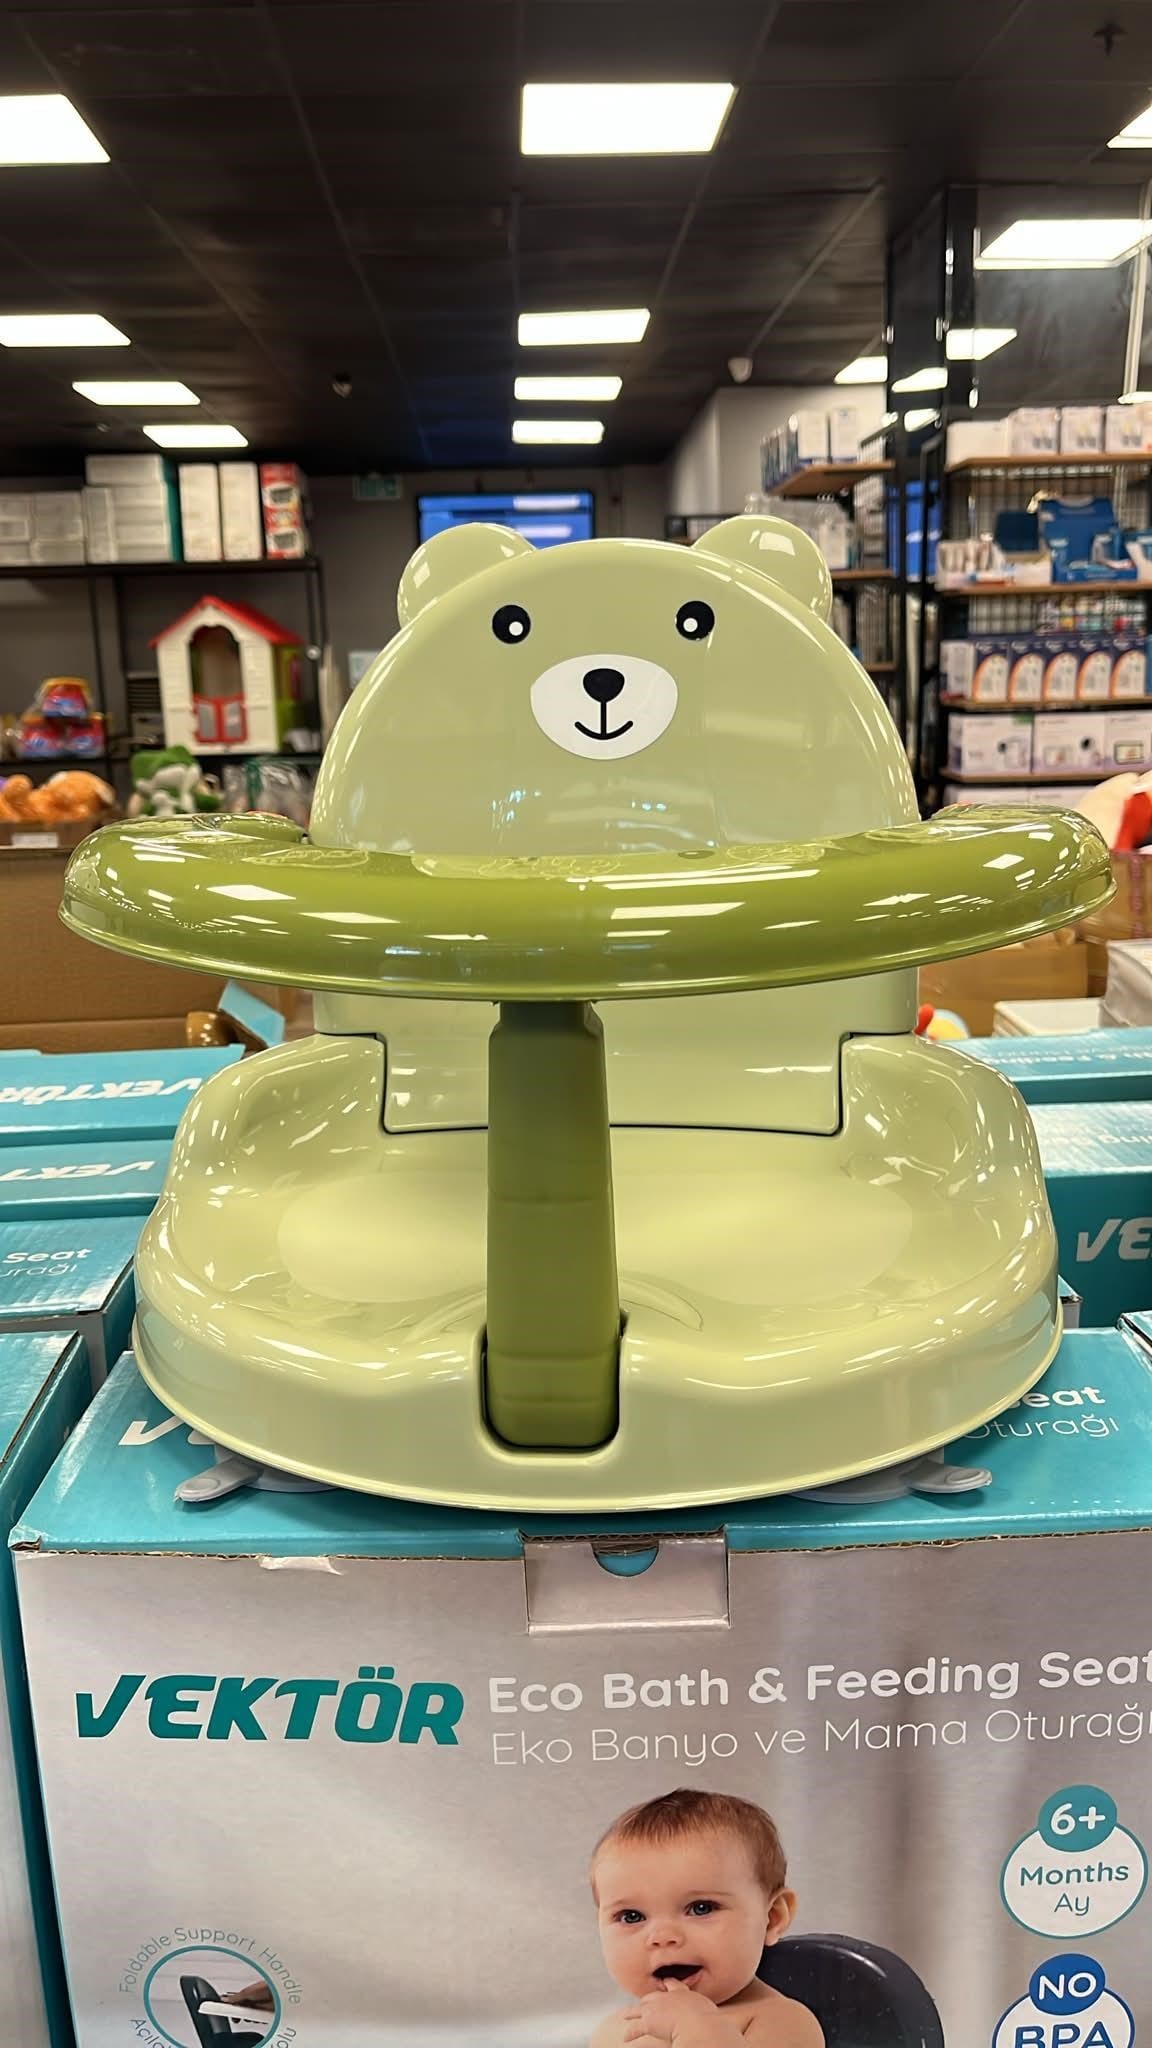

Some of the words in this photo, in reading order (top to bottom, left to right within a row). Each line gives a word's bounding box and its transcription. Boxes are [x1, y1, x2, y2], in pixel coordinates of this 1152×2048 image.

[2, 1248, 93, 1264] Seat
[1007, 1386, 1106, 1409] eat
[488, 1676, 583, 1713] Eco
[603, 1668, 729, 1709] Bath
[748, 1667, 787, 1704] &
[807, 1657, 1020, 1700] Feeding
[1038, 1649, 1152, 1688] Seat
[75, 1665, 465, 1745] VEKTÖR
[492, 1730, 573, 1765] Eko
[591, 1728, 738, 1766] Banyo
[754, 1729, 807, 1755] ve
[825, 1718, 967, 1751] Mama
[1050, 1802, 1106, 1836] 6+
[1020, 1862, 1129, 1887] Months
[1053, 1892, 1090, 1917] Ay
[118, 1934, 171, 1994] Foldable
[174, 1926, 256, 1953] Support
[259, 1947, 303, 2005] Handle
[1038, 1972, 1097, 2000] NO
[1014, 2020, 1115, 2048] BPA
